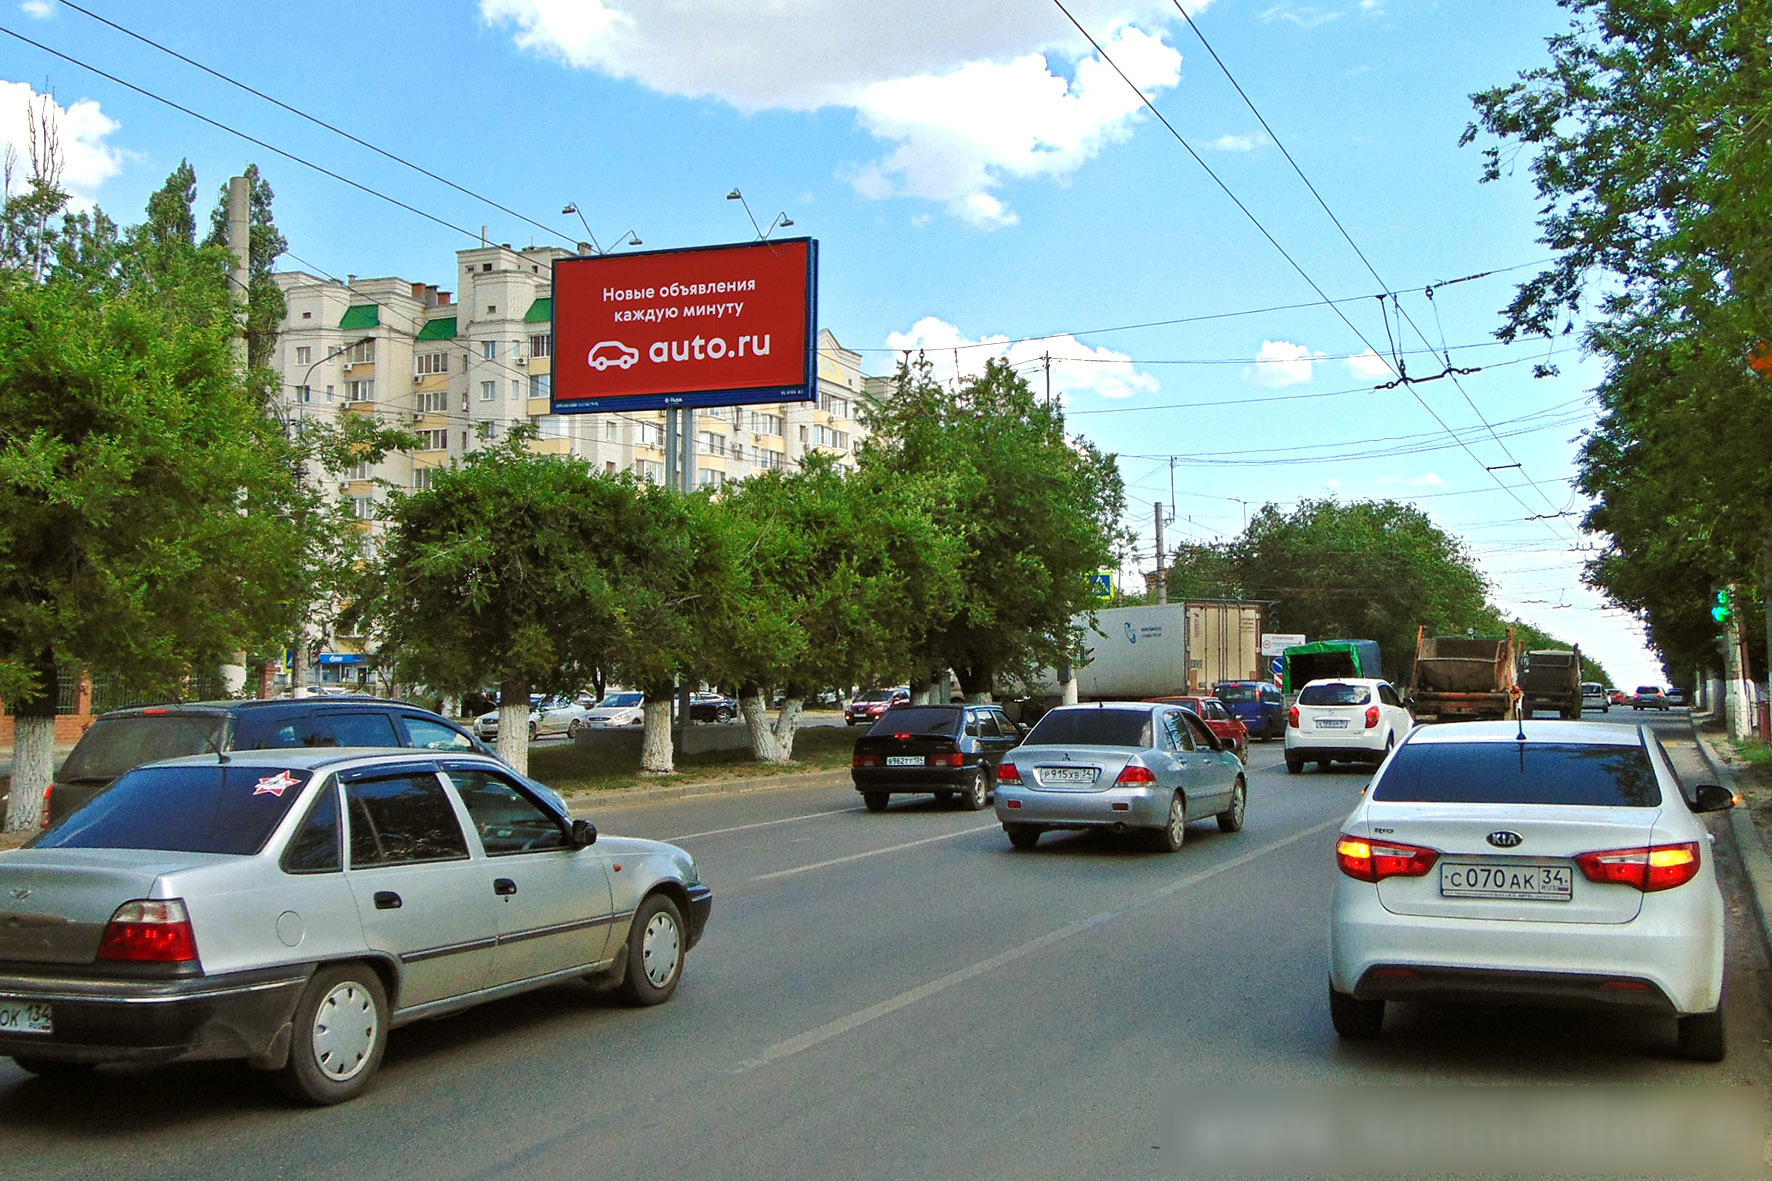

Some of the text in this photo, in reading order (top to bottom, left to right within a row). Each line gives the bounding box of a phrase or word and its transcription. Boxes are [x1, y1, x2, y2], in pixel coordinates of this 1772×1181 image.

[603, 278, 756, 302] Новые объявления
[614, 301, 744, 323] каждую минуту
[649, 334, 771, 363] auto.ru
[1044, 769, 1080, 780] Р915ХВ
[1492, 833, 1517, 845] KIA
[1450, 869, 1563, 889] С070АК 34
[25, 1004, 51, 1022] 134
